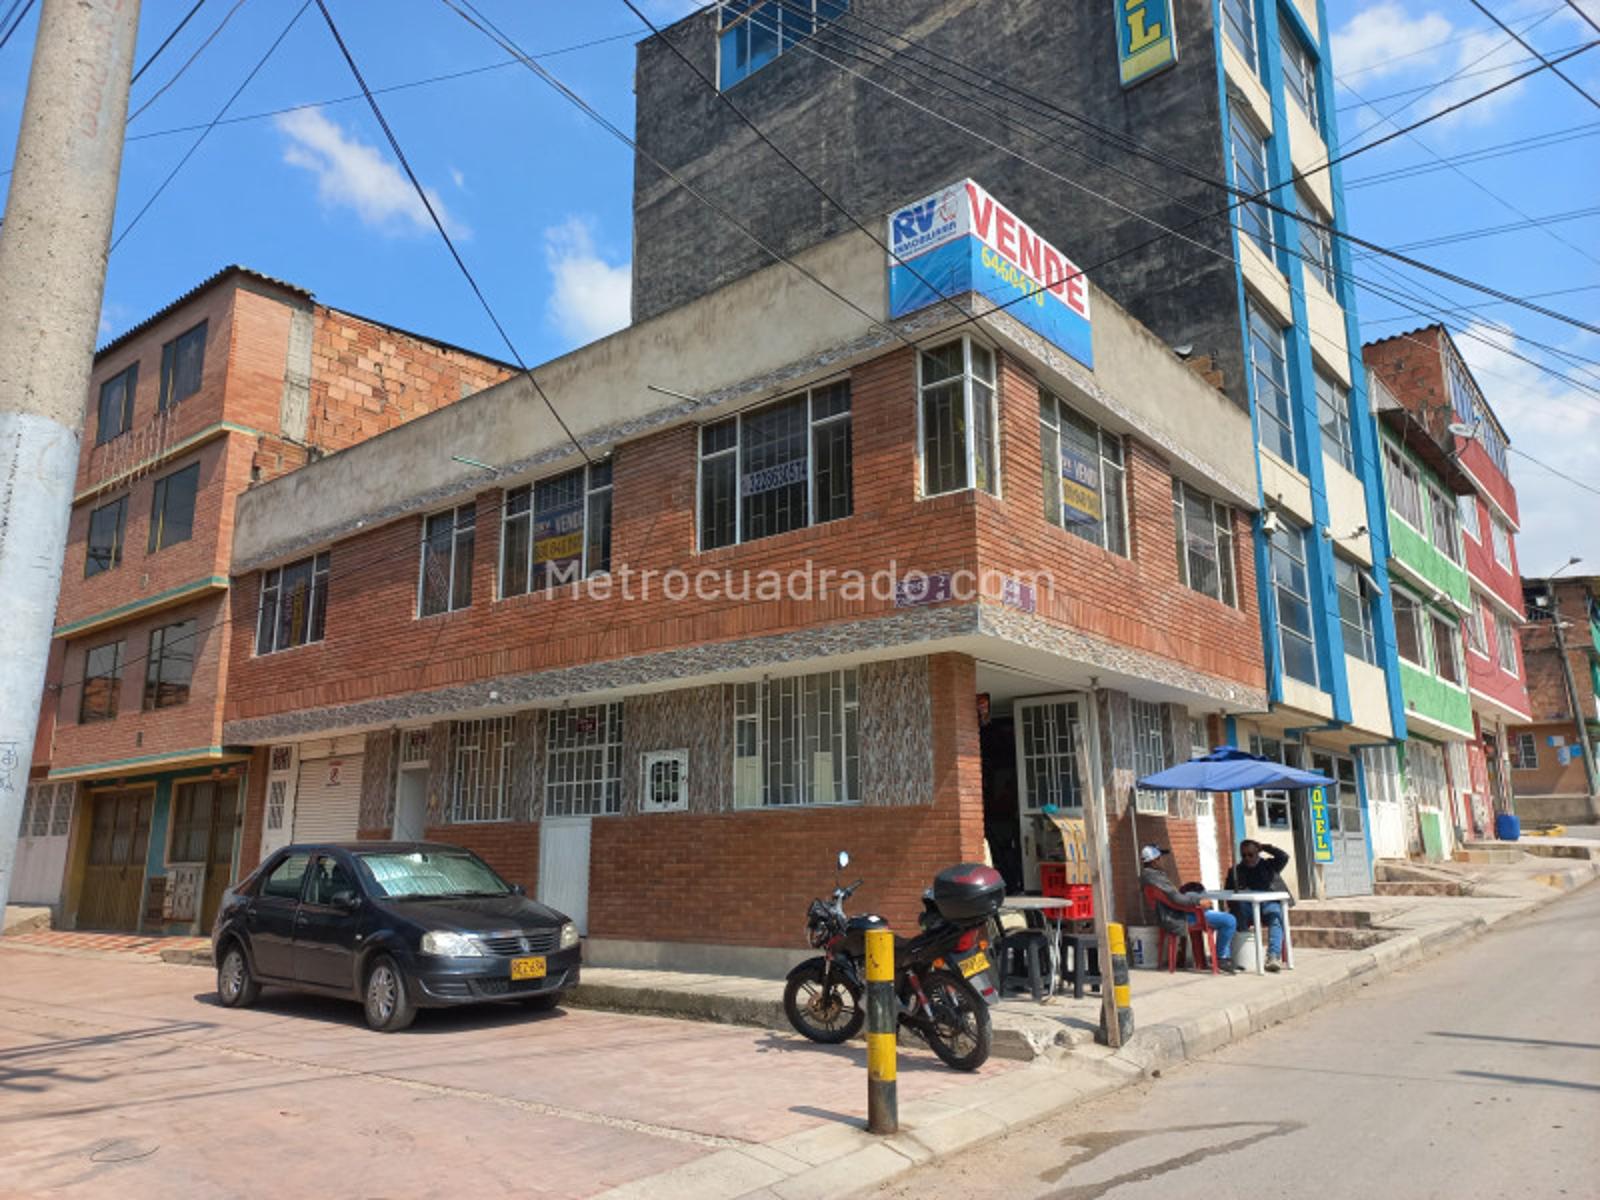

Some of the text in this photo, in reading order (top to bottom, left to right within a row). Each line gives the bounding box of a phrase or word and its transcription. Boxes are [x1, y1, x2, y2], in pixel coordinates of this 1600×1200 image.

[1124, 0, 1161, 53] L
[893, 199, 937, 245] RV
[965, 182, 1085, 314] VENDE
[1312, 786, 1328, 849] OTEL
